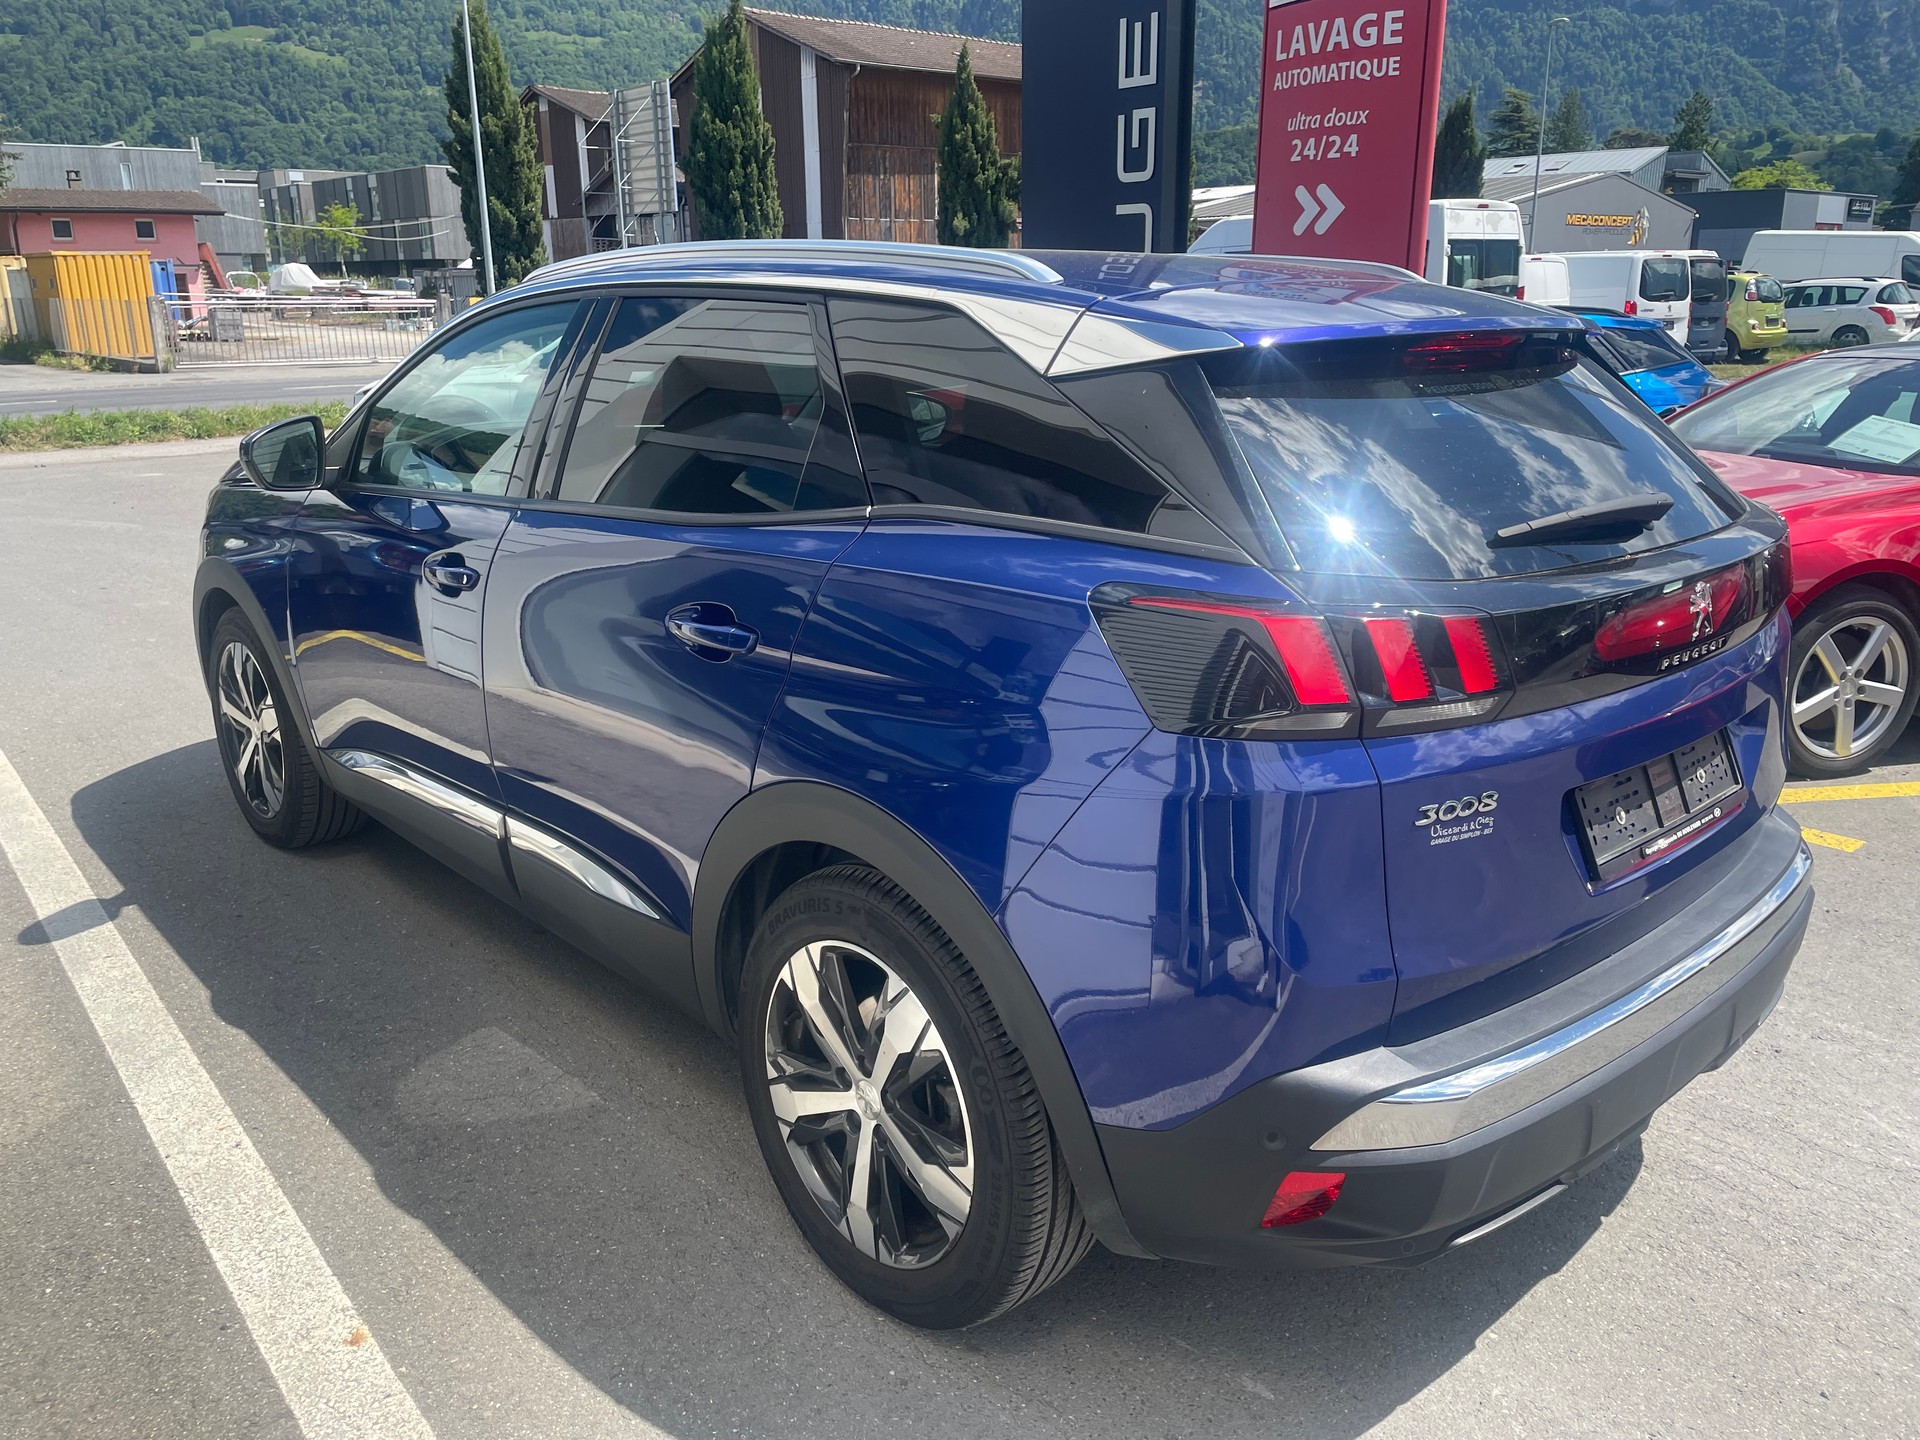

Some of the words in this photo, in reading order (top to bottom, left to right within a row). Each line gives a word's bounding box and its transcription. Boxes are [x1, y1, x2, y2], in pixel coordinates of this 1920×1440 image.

[1275, 9, 1404, 62] LAVAGE
[1273, 56, 1401, 91] AUTOMATIQUE
[1287, 111, 1321, 132] ultra
[1324, 108, 1369, 128] doux
[1291, 134, 1359, 162] 24/24
[1660, 637, 1726, 670] PEUGEOT
[1414, 791, 1498, 826] 3008
[767, 897, 831, 935] BRAVURIS
